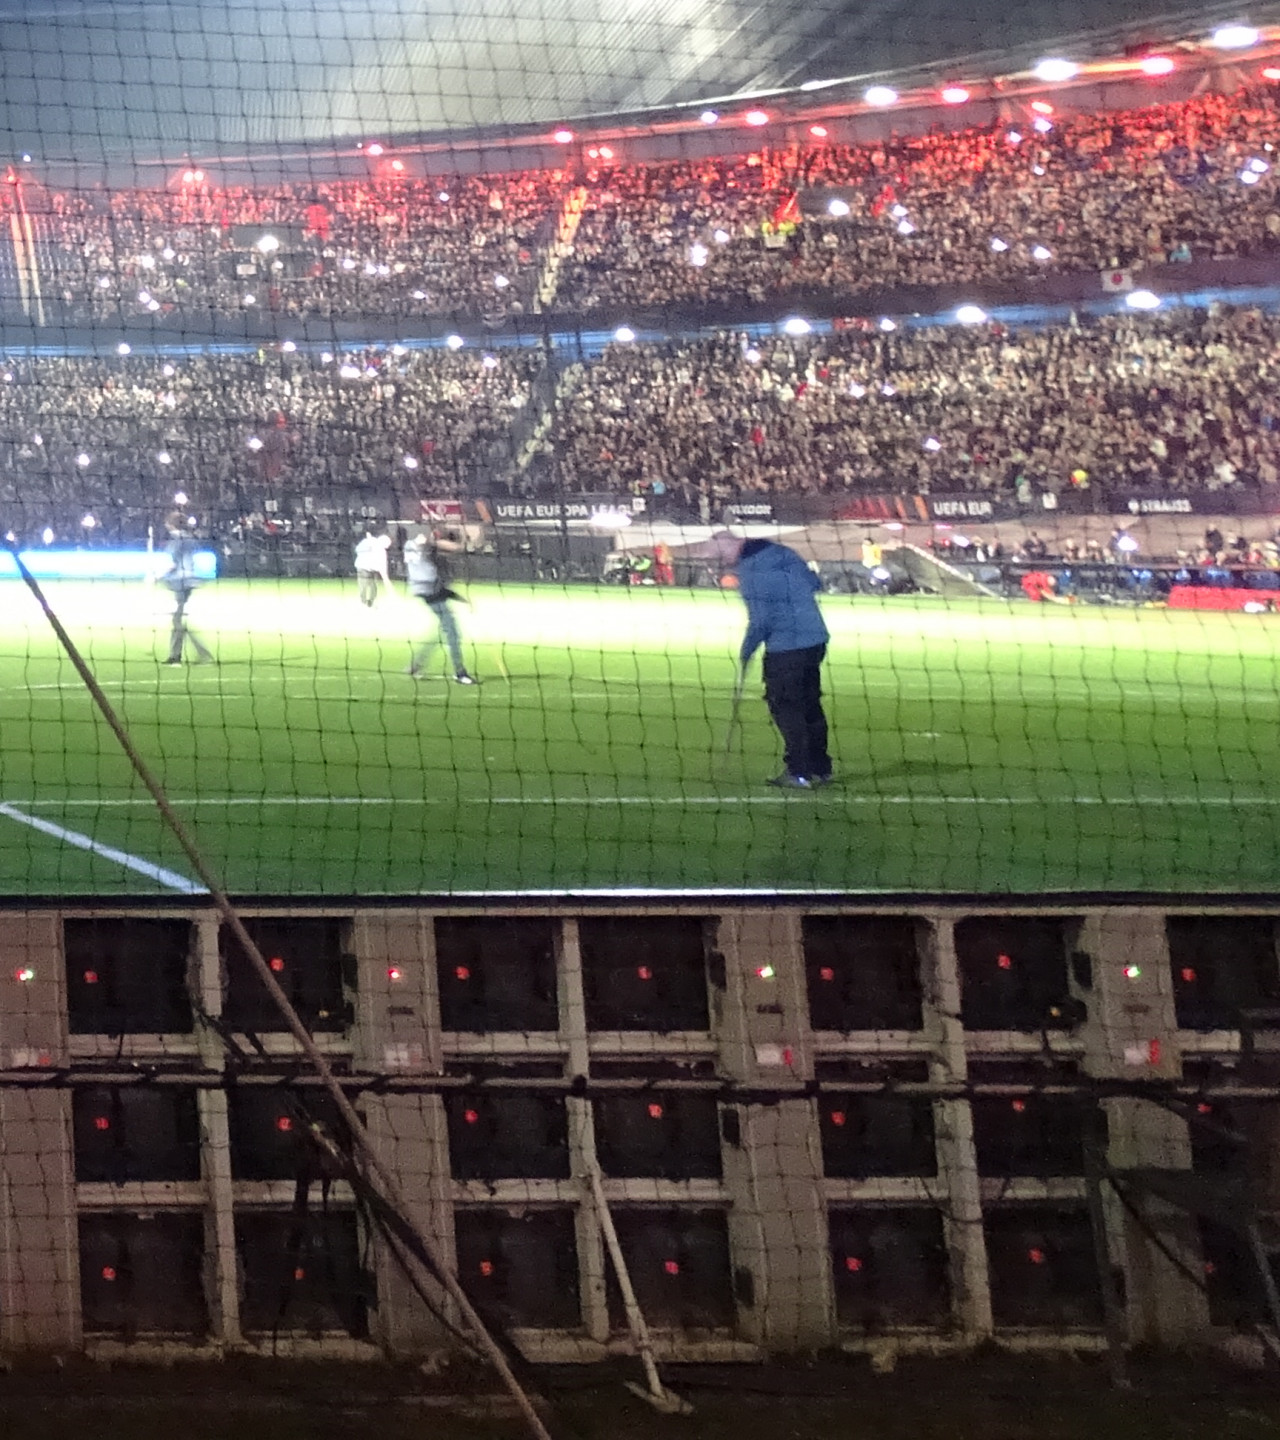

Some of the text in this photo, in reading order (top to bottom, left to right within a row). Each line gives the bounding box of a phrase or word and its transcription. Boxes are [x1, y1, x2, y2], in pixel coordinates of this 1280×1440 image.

[497, 505, 534, 517] UEFA
[934, 501, 992, 515] UEFA EUR
